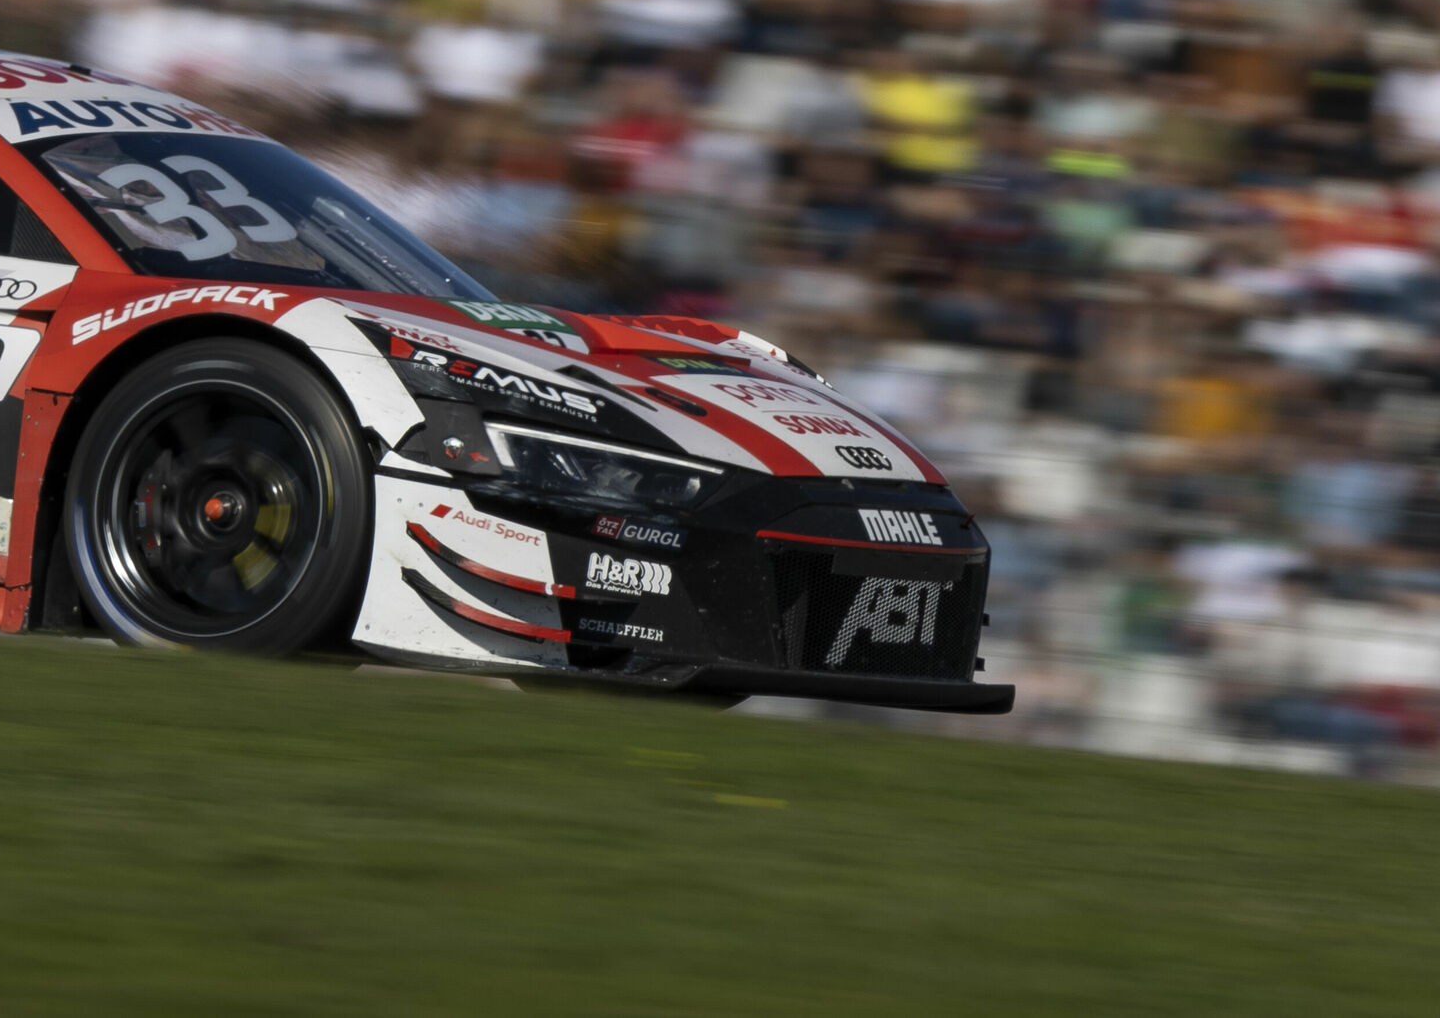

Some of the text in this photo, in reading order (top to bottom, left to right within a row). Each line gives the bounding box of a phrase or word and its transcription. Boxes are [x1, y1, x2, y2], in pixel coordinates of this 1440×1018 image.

[97, 154, 298, 261] 33
[72, 285, 290, 345] SÜDPACK
[413, 349, 598, 414] REMUS
[539, 399, 598, 423] EXHAUSTS
[773, 414, 872, 439] SONAX
[452, 510, 541, 547] Audi Sport
[596, 526, 615, 536] TAL
[598, 517, 620, 530] ÖTZ
[623, 525, 681, 548] GURGL
[858, 508, 943, 546] MAHLE
[585, 581, 602, 590] Das
[587, 552, 642, 590] H&R
[579, 618, 664, 642] SCHAEFFLER
[824, 576, 942, 668] ABT
